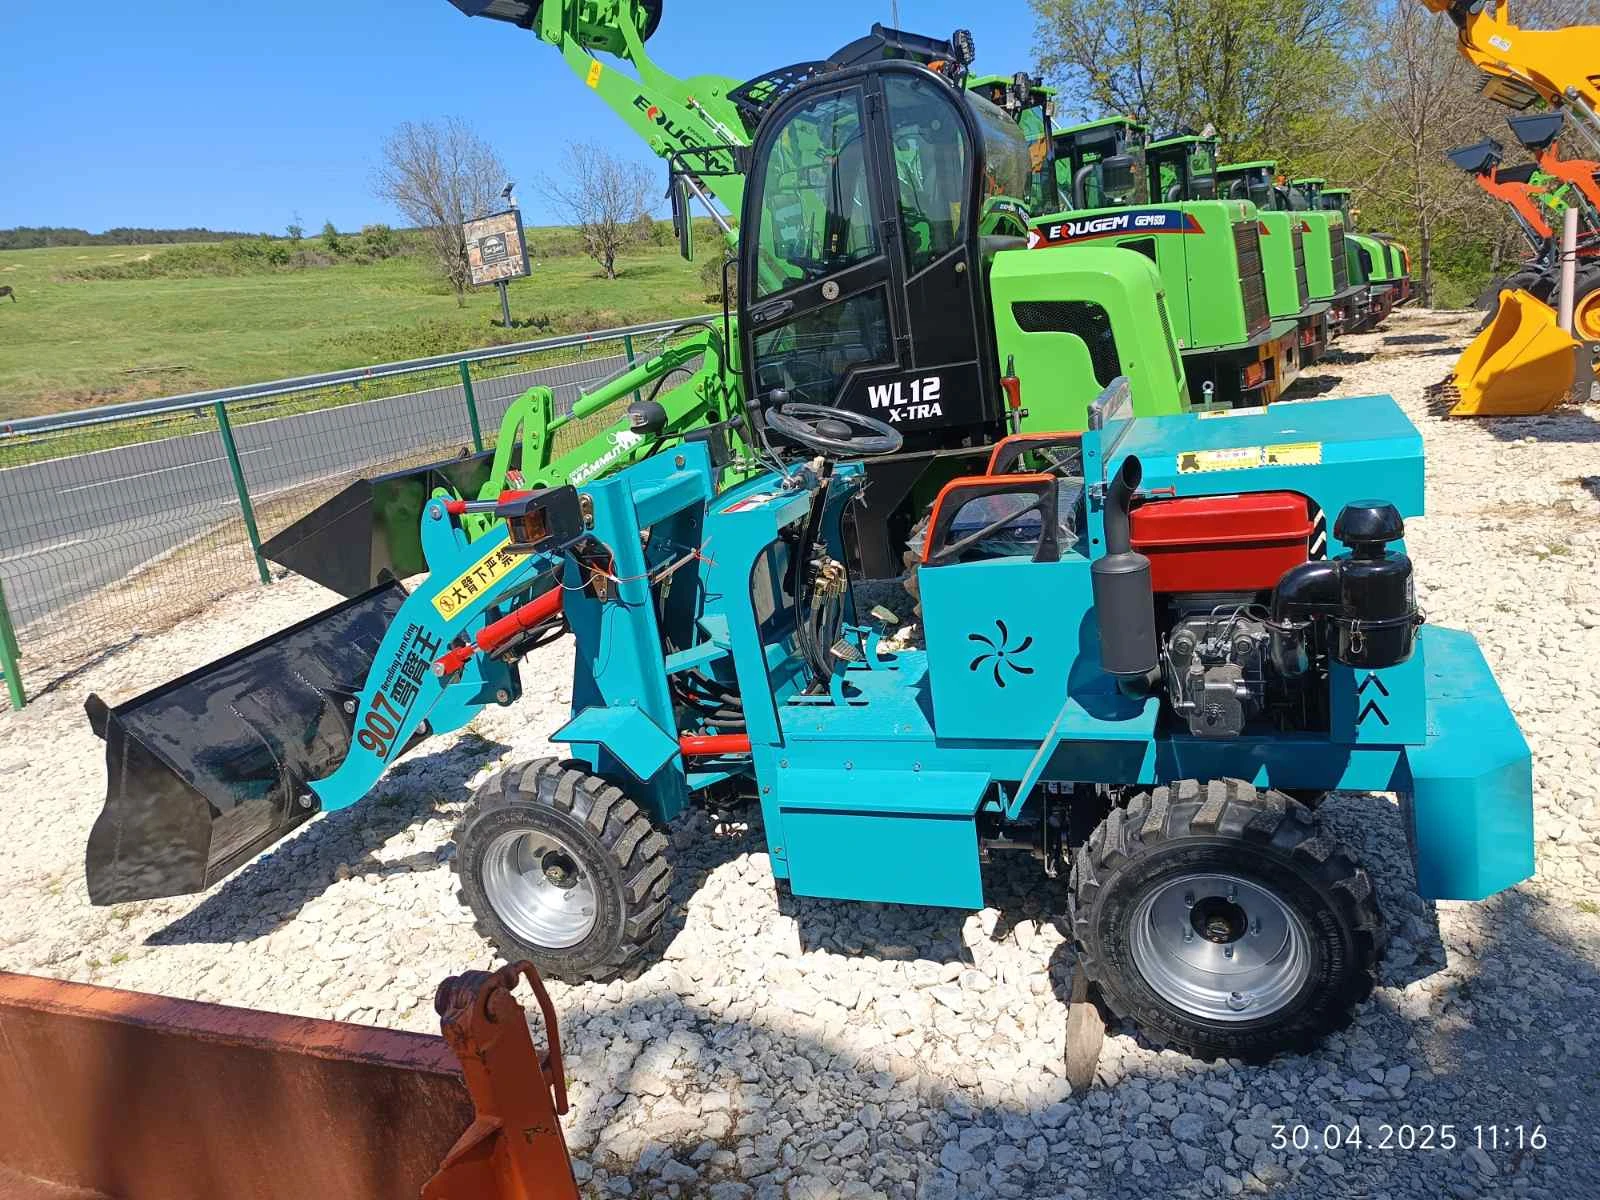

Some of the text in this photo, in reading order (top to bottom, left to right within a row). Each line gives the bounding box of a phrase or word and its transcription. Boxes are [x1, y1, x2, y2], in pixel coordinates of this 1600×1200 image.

[867, 376, 941, 409] WL12
[888, 402, 943, 423] X-TRA
[451, 542, 519, 605] 大臂下严禁
[405, 622, 419, 645] King
[357, 690, 402, 758] 907
